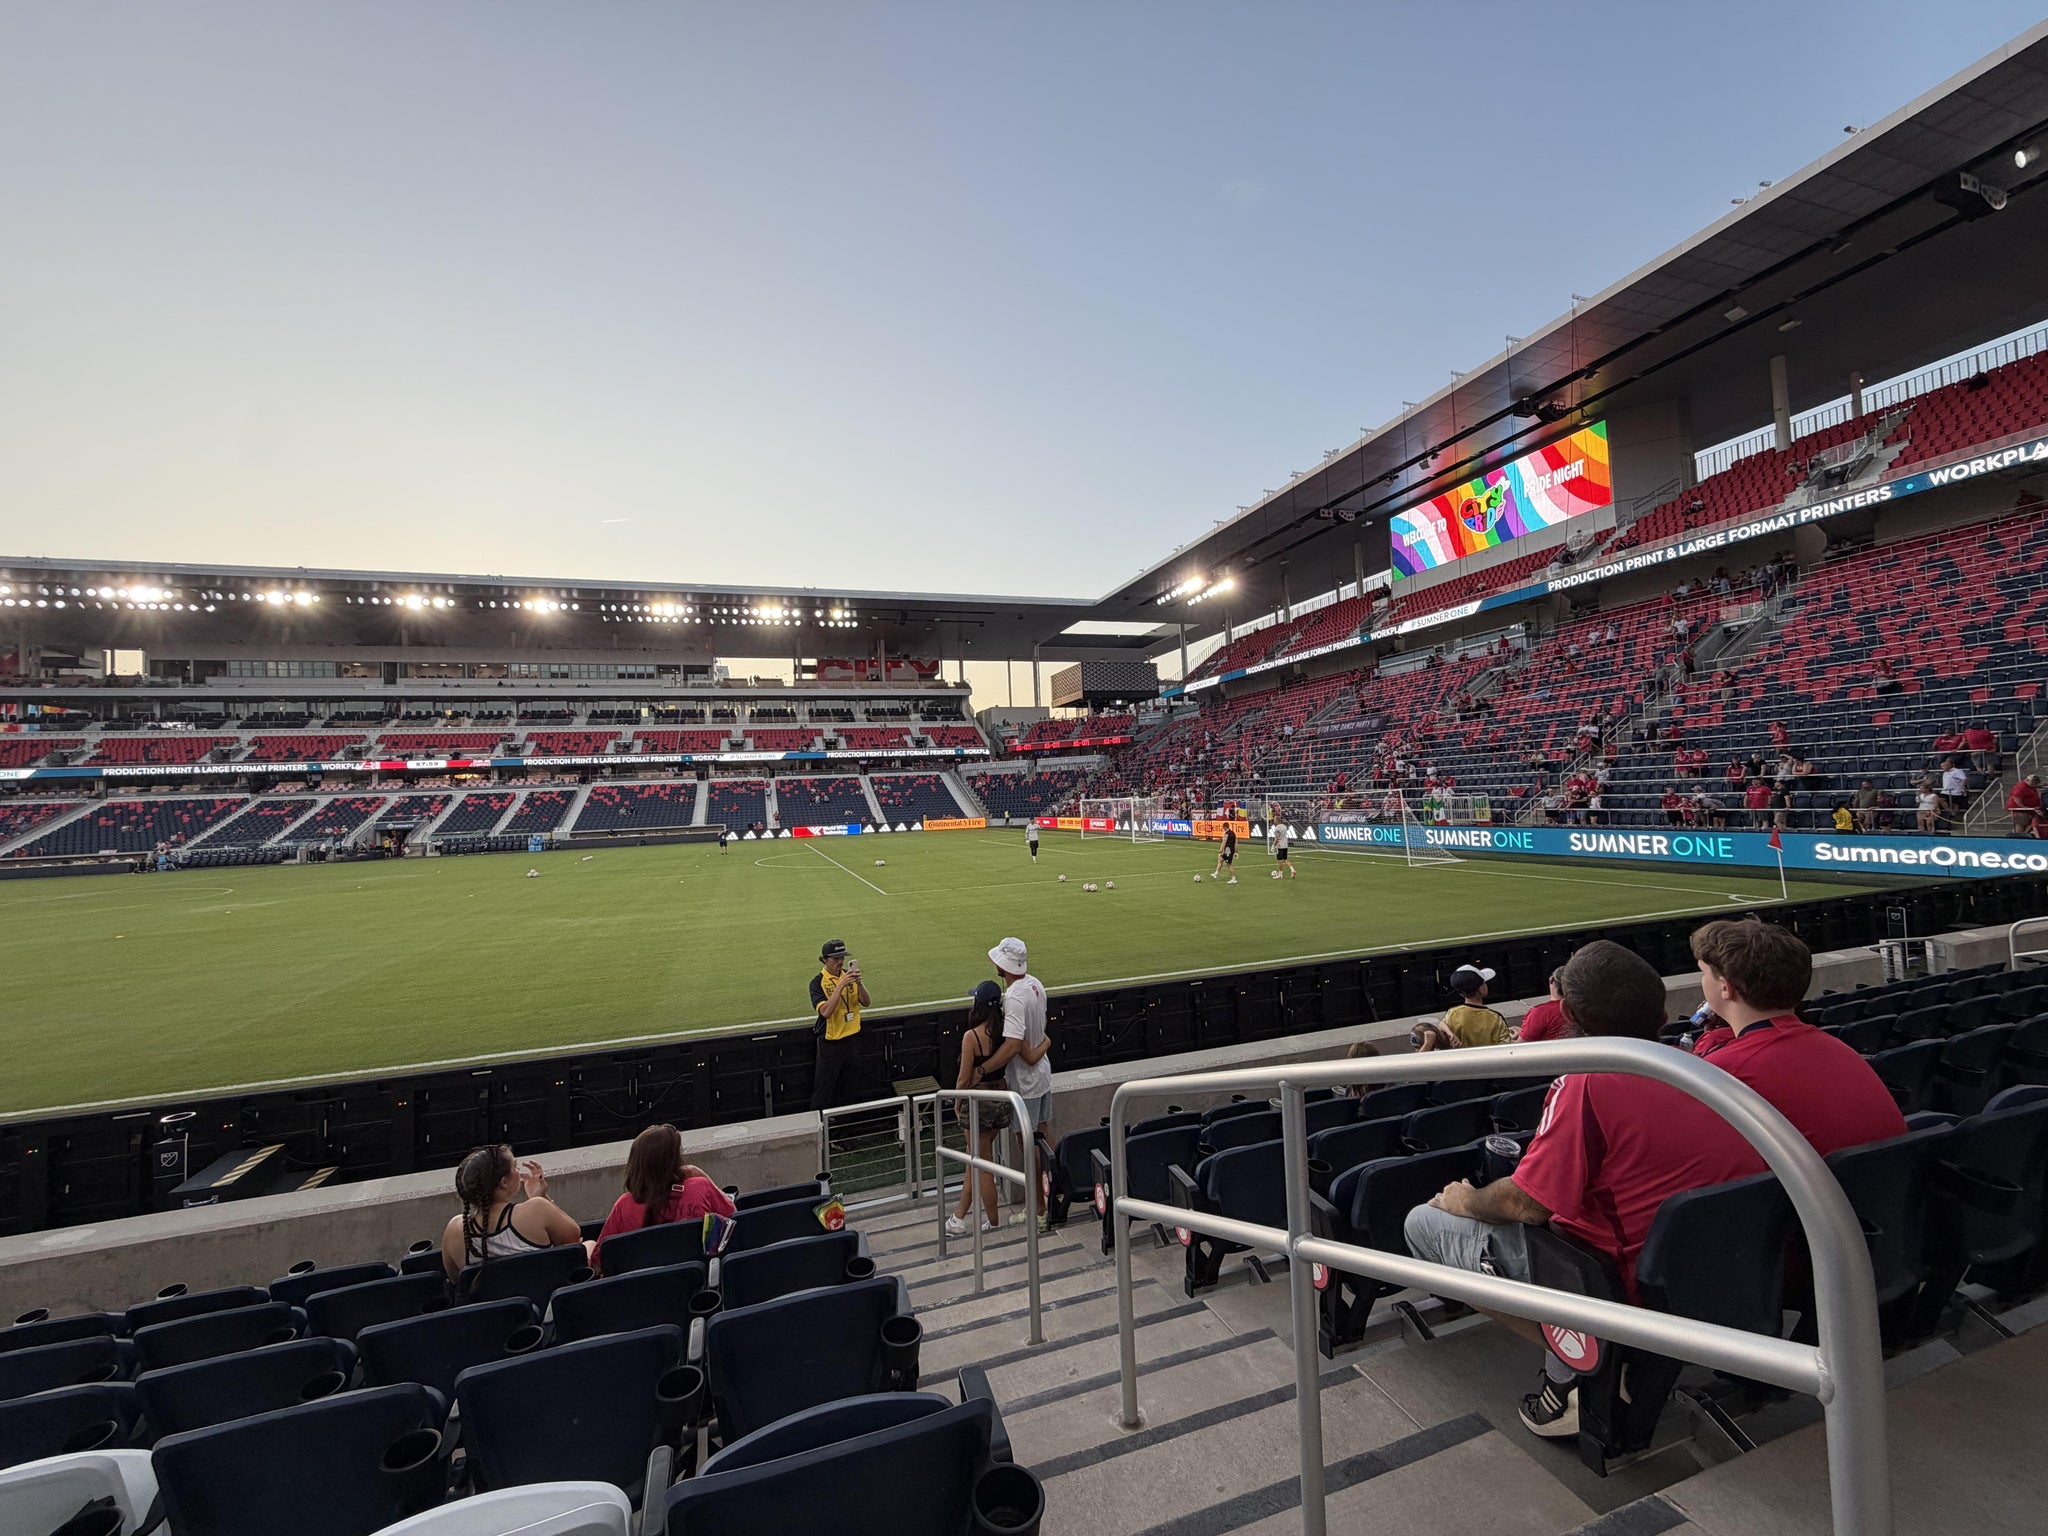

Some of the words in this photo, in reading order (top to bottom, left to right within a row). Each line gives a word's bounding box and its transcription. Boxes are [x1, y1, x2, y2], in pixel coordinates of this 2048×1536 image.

[1523, 472, 1552, 498] PRIDE
[1552, 458, 1585, 486] NIGHT
[1436, 517, 1447, 533] TO
[1547, 562, 1624, 592] PRODUCTION
[1625, 550, 1664, 571] PRINT
[1666, 547, 1677, 560] &
[1678, 532, 1726, 556] LARGE
[1728, 512, 1797, 542] FORMAT
[1800, 485, 1893, 522] PRINTERS
[1245, 660, 1275, 675] PRODUCTION
[1274, 656, 1290, 668] PRINT
[1293, 649, 1311, 662] LARGE
[1310, 644, 1333, 657] FORMAT
[1332, 636, 1361, 651] PRINTERS
[102, 767, 165, 776] PRODUCTION
[165, 766, 192, 775] PRINT
[193, 766, 201, 774] &
[201, 765, 230, 774] LARGE
[231, 764, 272, 773] FORMAT
[272, 763, 308, 772] PRINTERS
[523, 758, 570, 766] PRODUCTION
[650, 755, 682, 763] PRINTERS
[1172, 822, 1192, 832] ULTRA
[1814, 842, 2048, 871] SumnerOne.co
